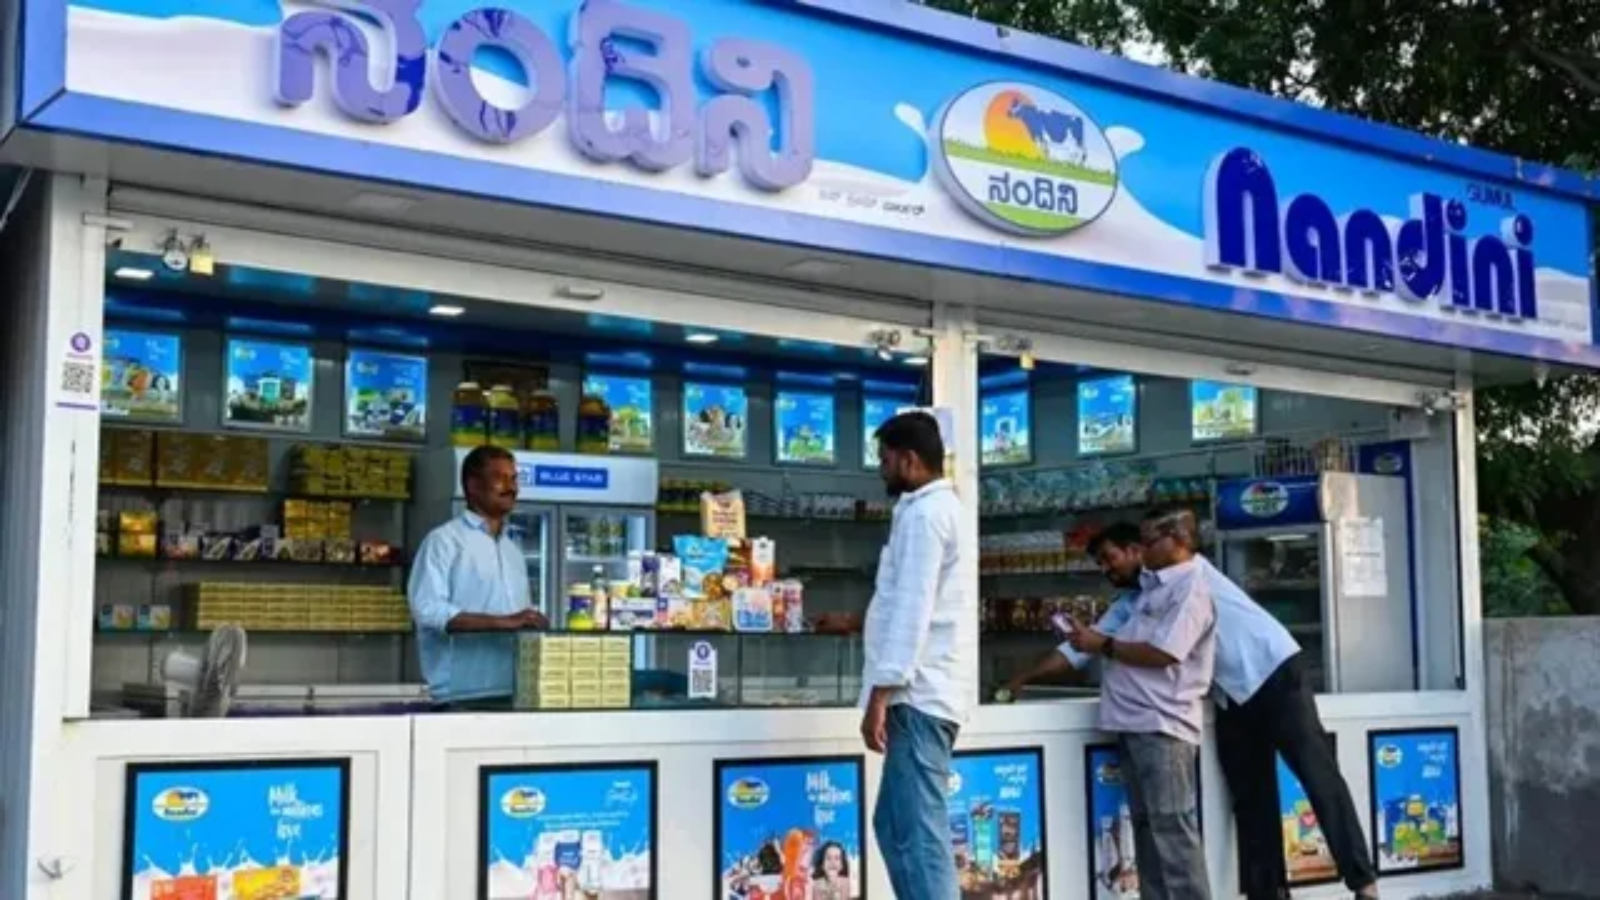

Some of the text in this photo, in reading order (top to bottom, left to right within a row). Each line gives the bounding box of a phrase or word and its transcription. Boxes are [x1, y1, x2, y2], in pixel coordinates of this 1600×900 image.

[276, 0, 814, 191] ನಂದಿನಿ
[988, 172, 1078, 215] ನಂದಿನಿ
[1206, 147, 1537, 319] Nandini
[540, 471, 604, 484] BLUE STAR
